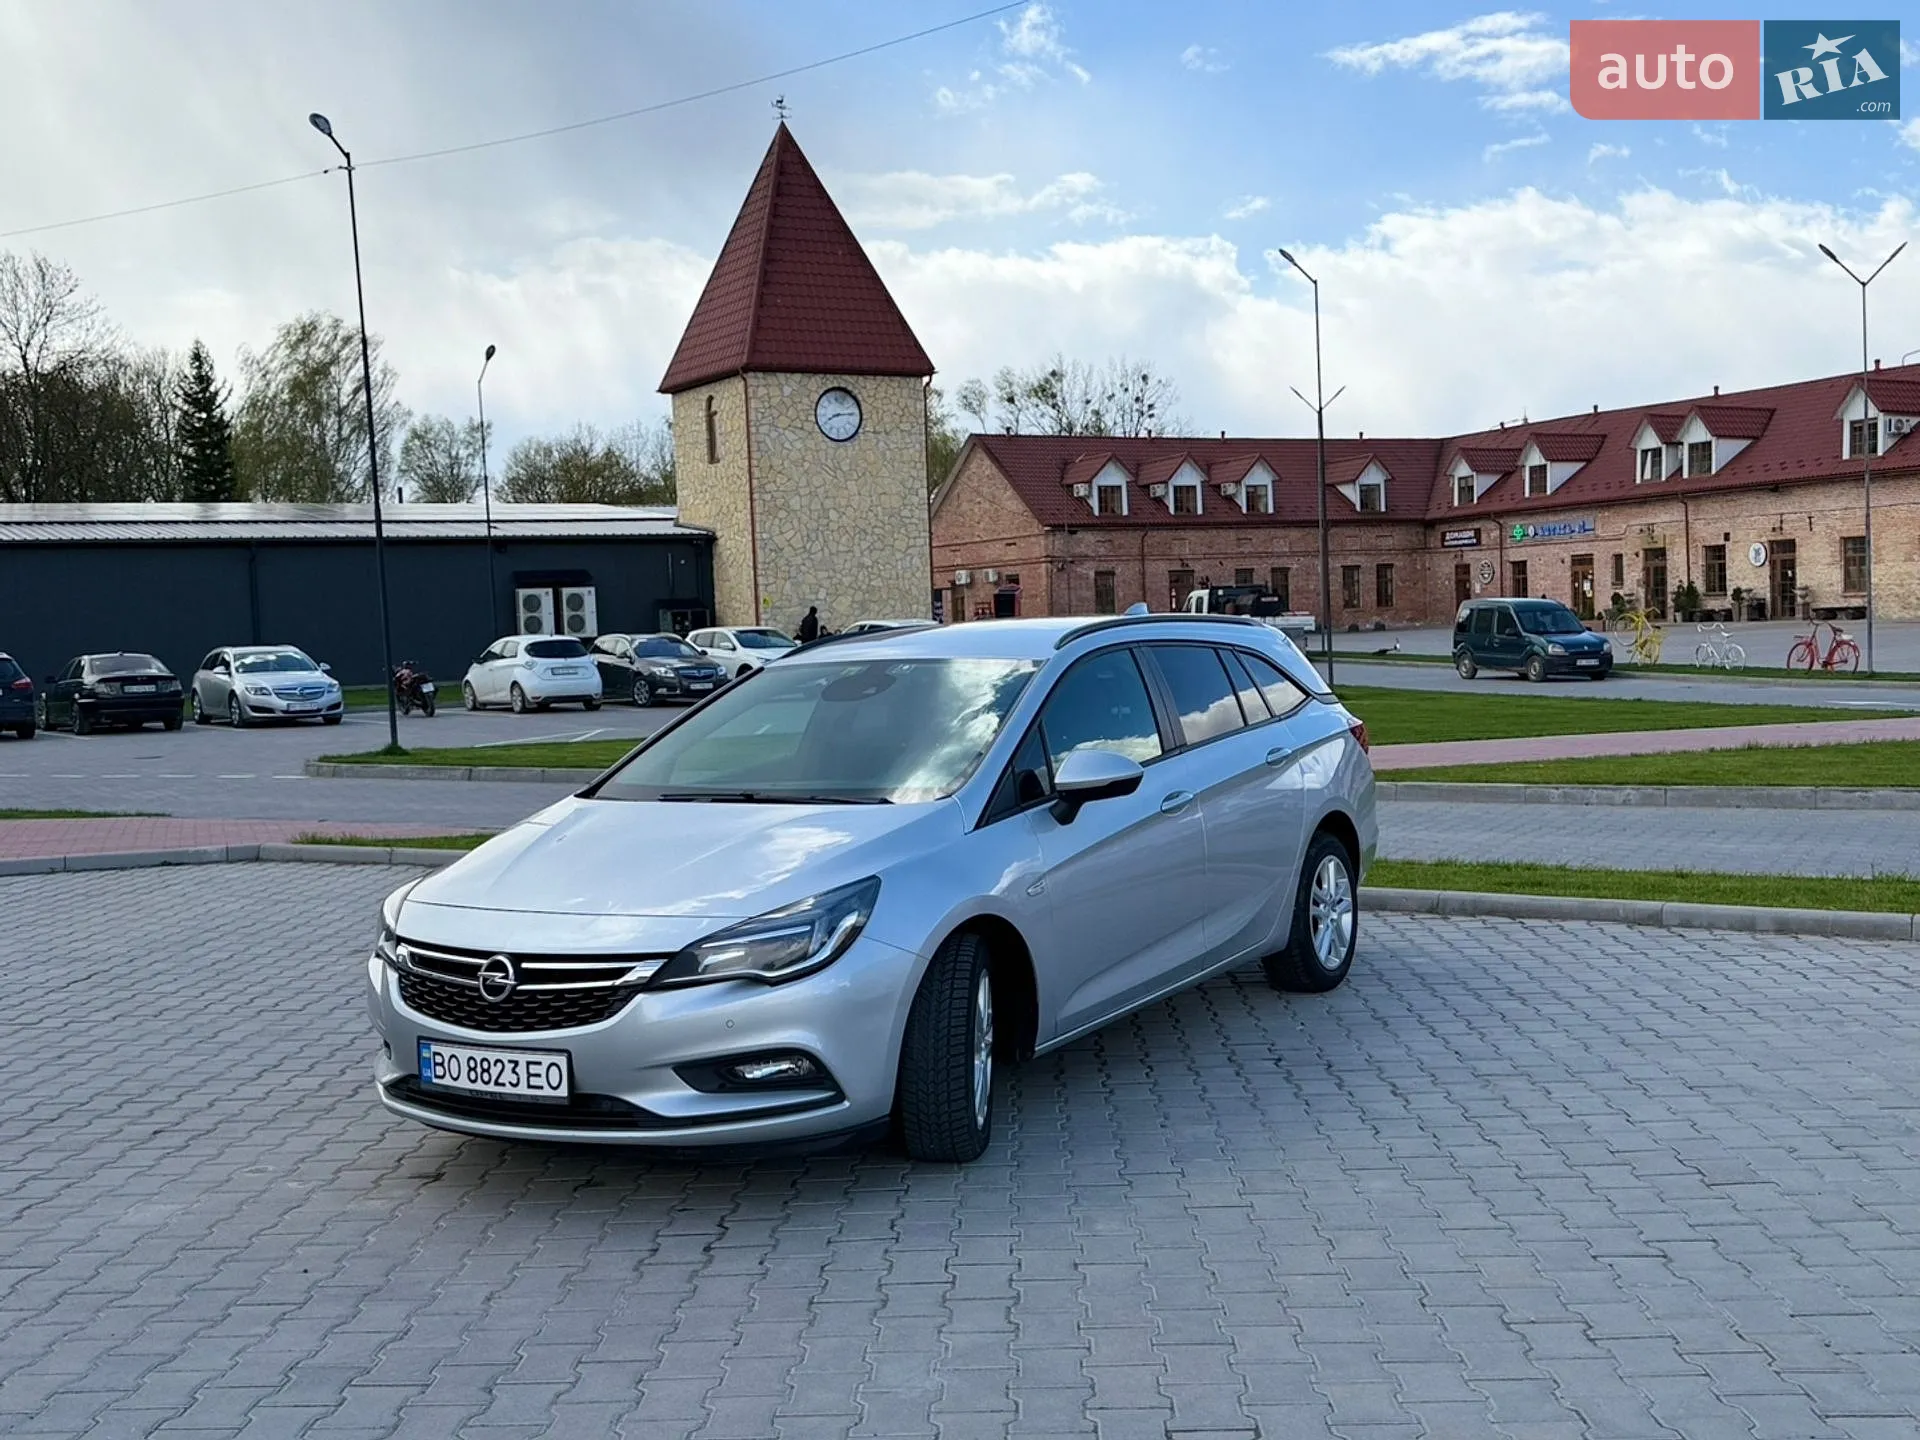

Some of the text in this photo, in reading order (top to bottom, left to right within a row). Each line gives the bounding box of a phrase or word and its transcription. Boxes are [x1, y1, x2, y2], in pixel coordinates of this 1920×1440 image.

[432, 1051, 563, 1091] BO 8823 EO
